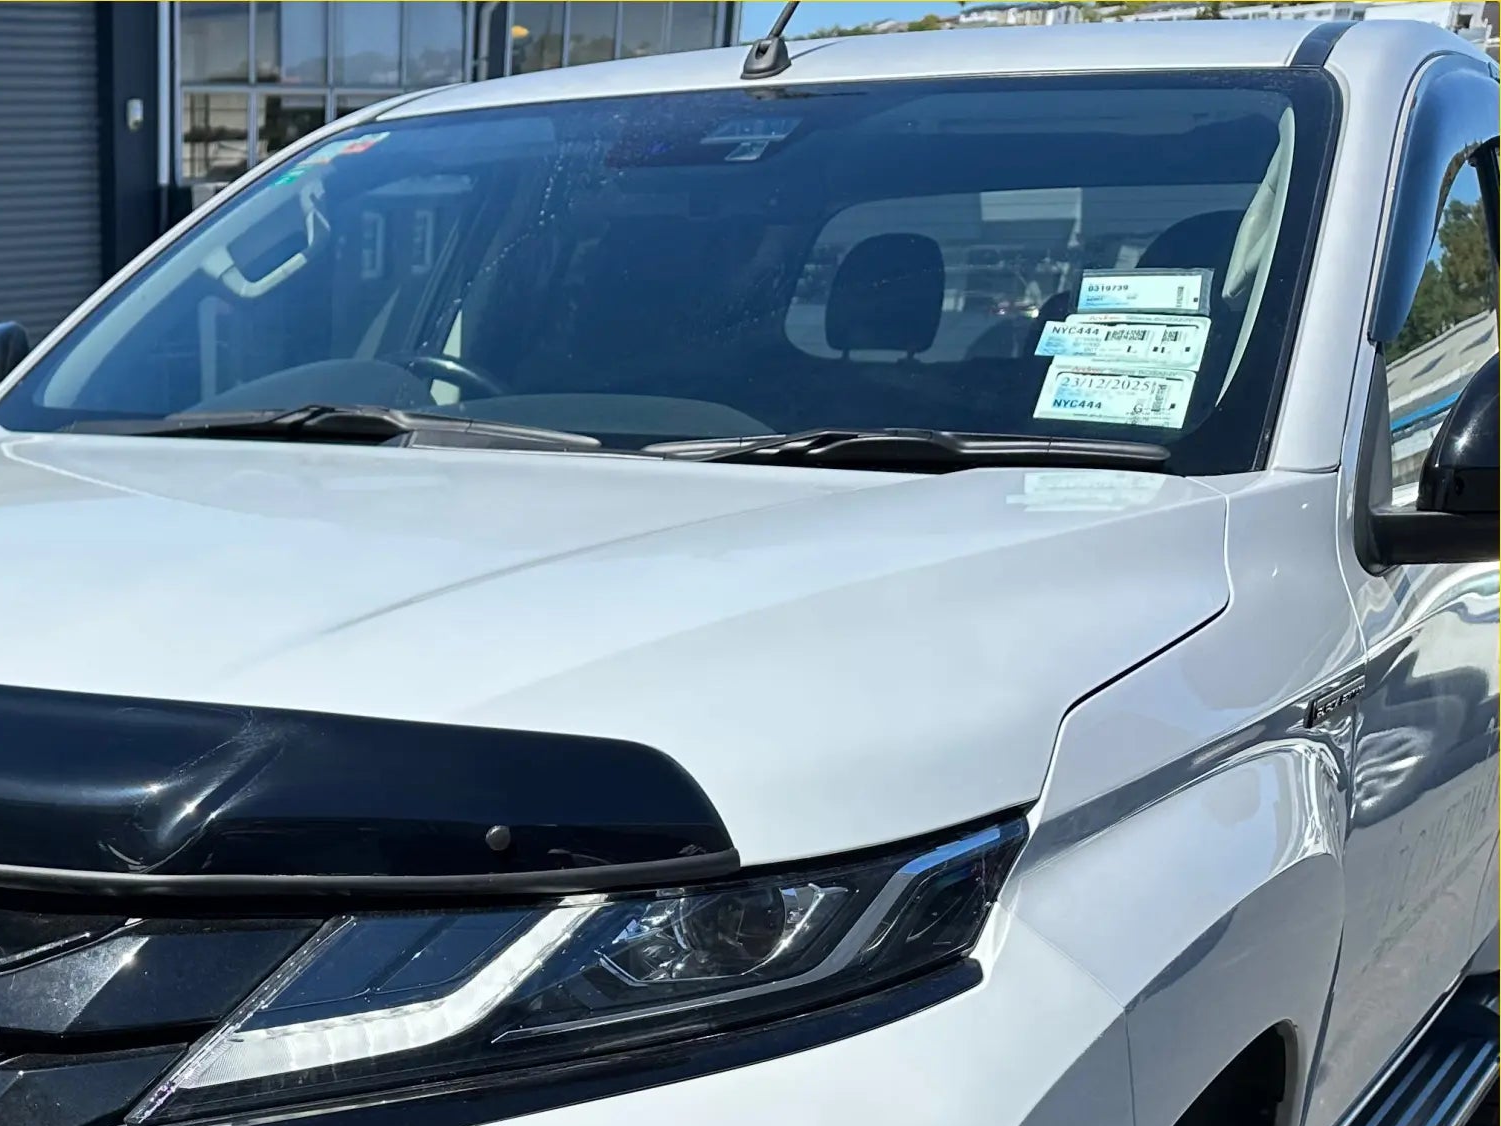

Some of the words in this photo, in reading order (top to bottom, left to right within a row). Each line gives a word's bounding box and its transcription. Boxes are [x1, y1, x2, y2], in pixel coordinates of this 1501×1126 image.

[1052, 326, 1100, 336] NYC444
[1060, 376, 1151, 391] 23/12/2025
[1052, 398, 1103, 409] NYC444
